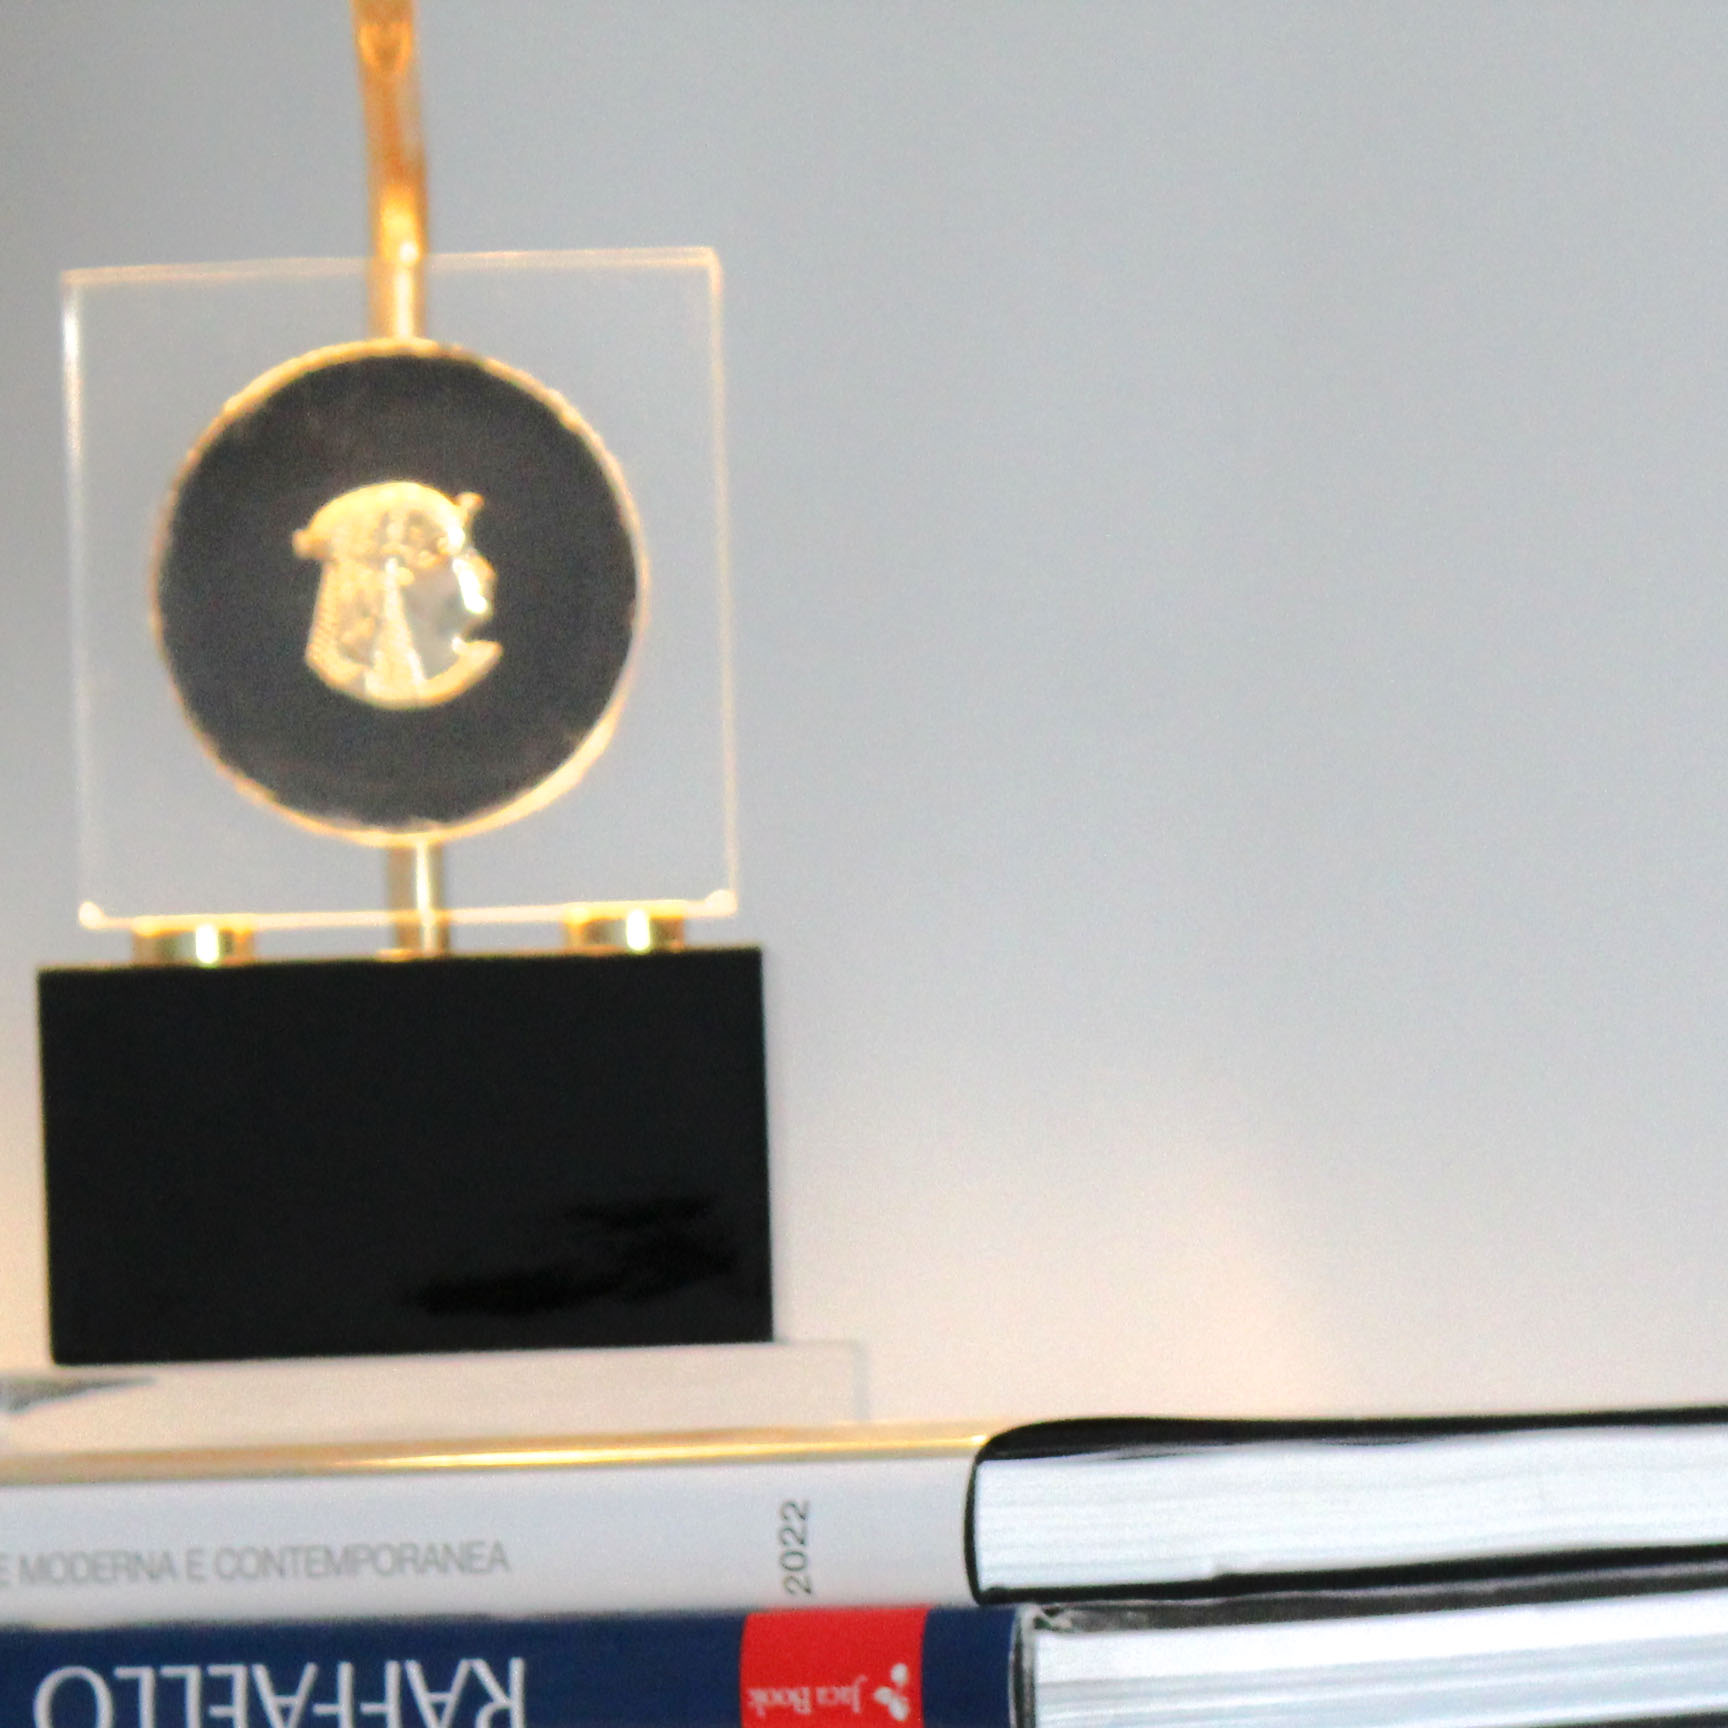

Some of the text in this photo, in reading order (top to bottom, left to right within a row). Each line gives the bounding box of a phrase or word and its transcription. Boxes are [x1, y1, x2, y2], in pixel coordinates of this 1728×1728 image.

[18, 1548, 175, 1586] MODERNA
[185, 1547, 206, 1582] E
[214, 1541, 510, 1581] CONTEMPORANEA
[779, 1499, 812, 1596] 2022
[748, 1673, 868, 1718] Jaca Book
